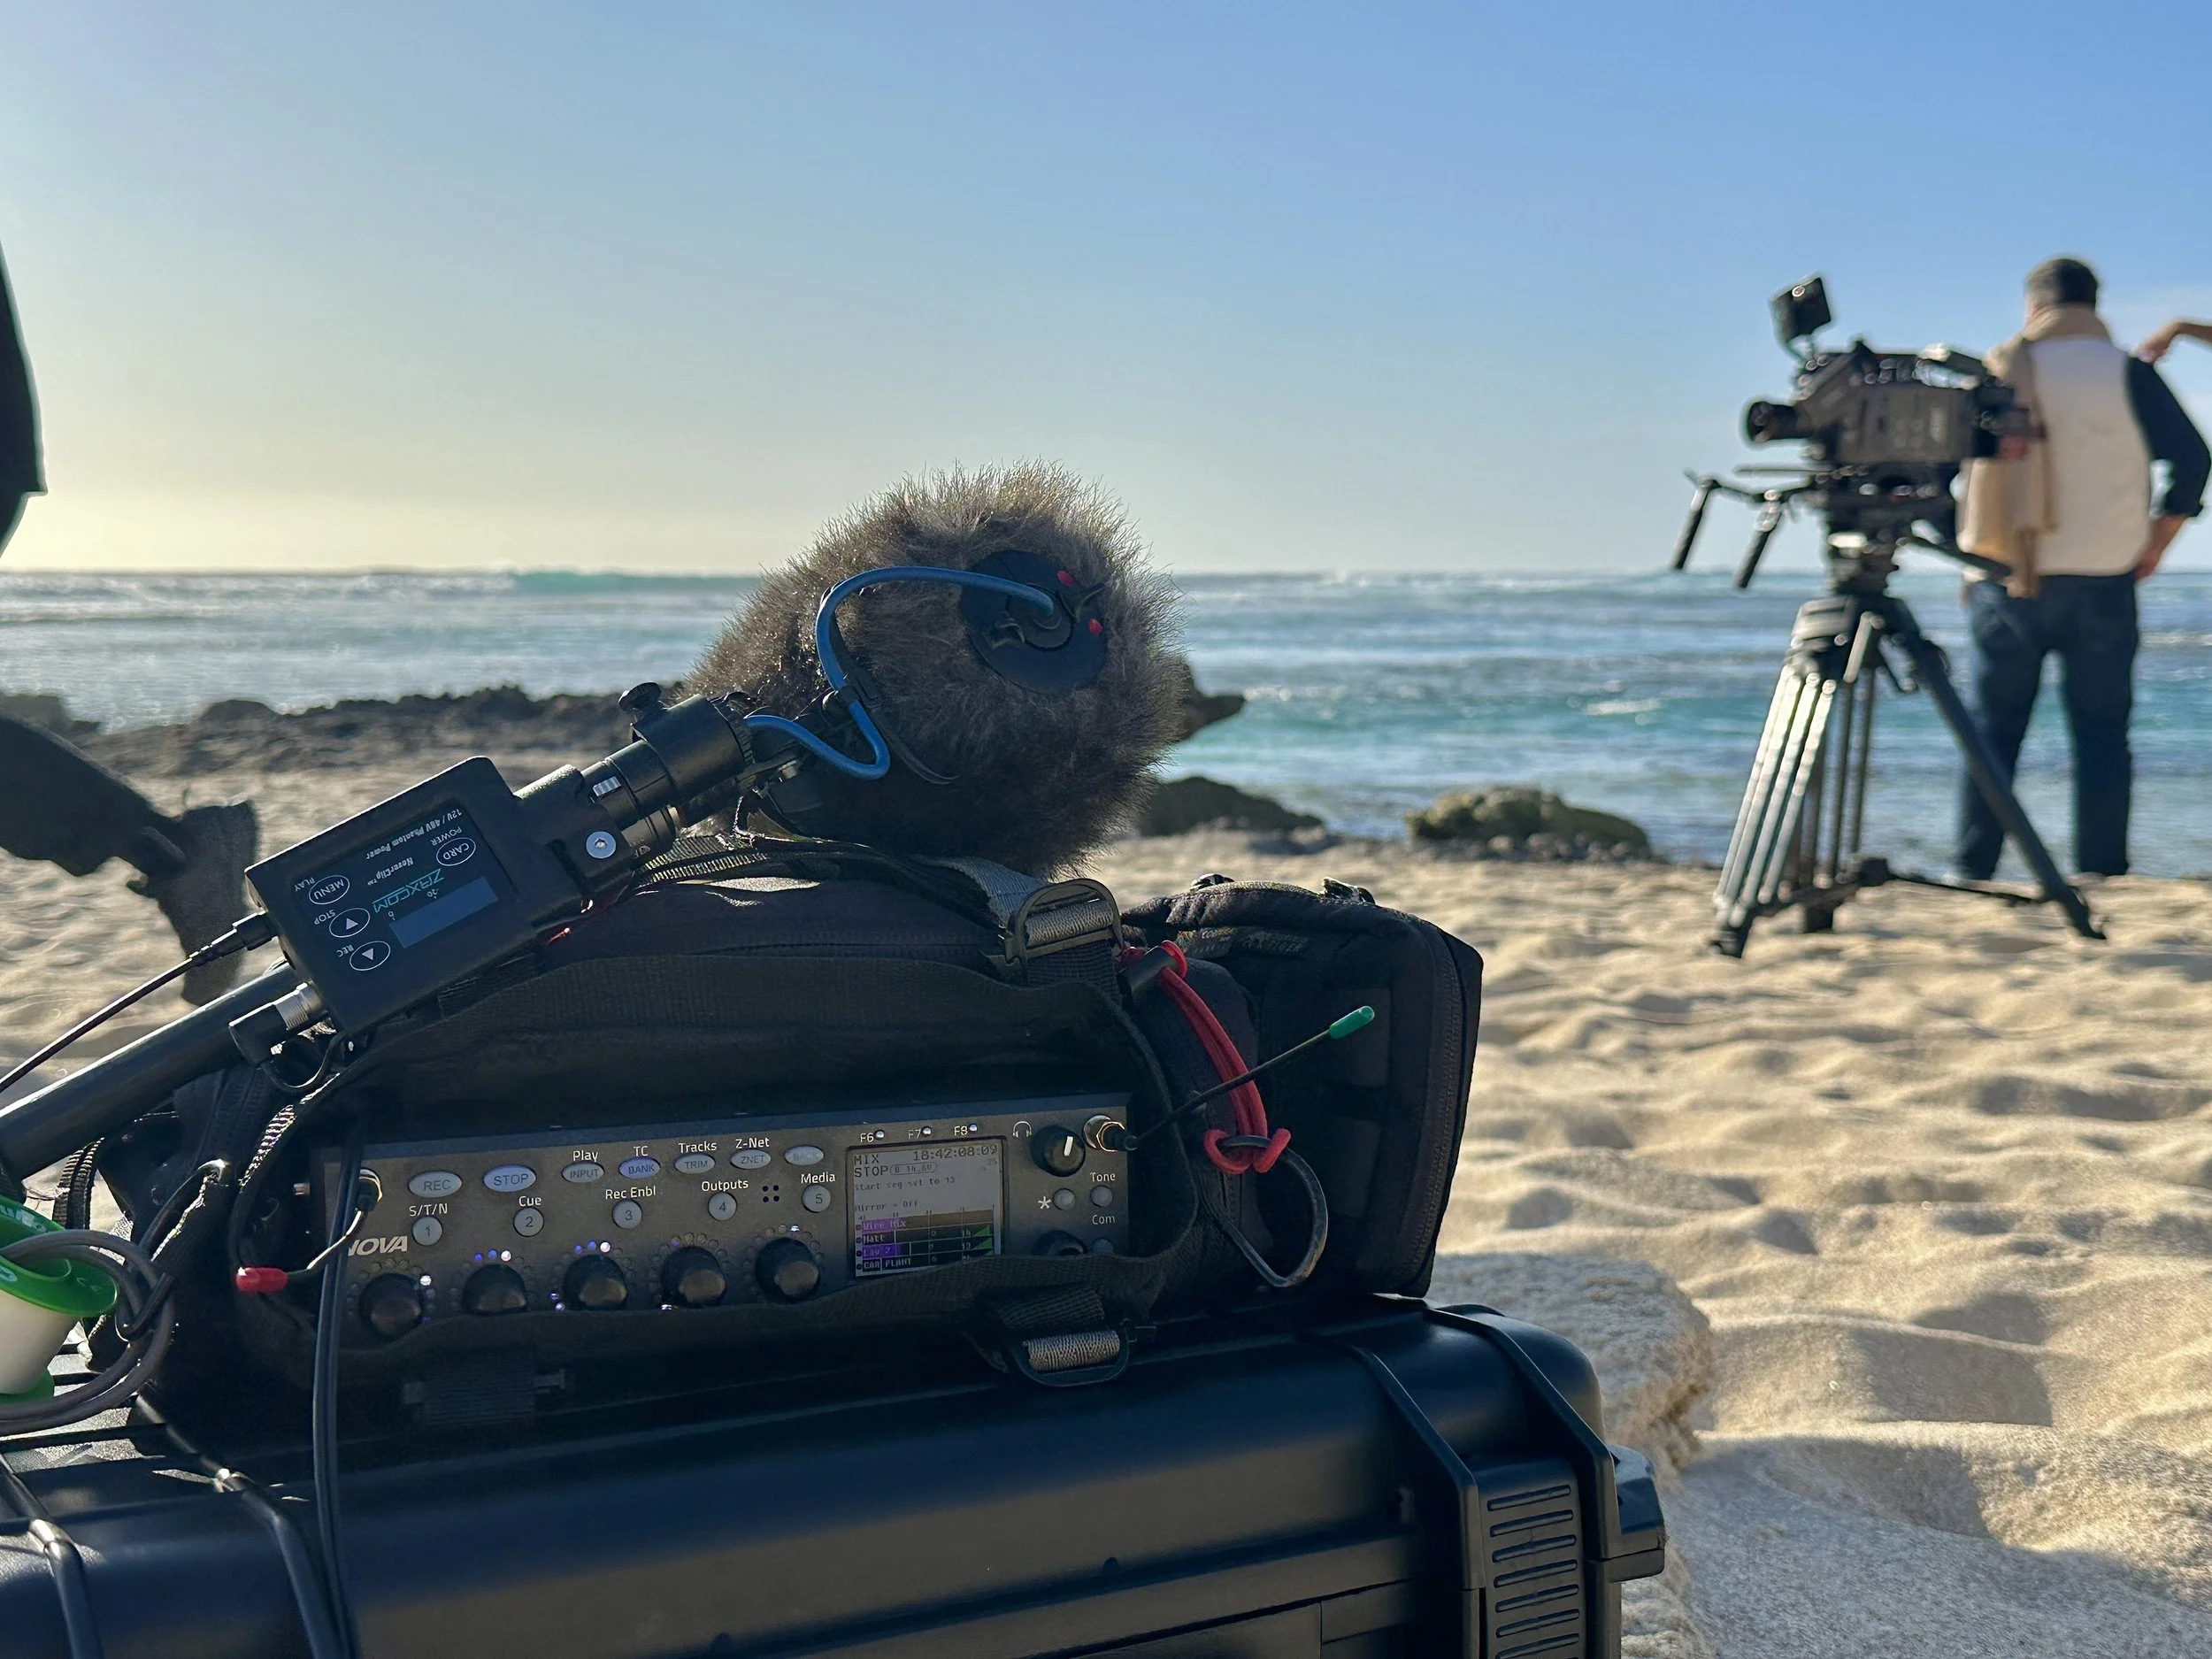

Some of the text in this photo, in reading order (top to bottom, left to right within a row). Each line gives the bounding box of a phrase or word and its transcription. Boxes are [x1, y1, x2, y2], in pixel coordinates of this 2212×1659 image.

[447, 808, 462, 821] 12V
[391, 826, 425, 847] Phantom
[430, 826, 463, 846] POWER
[365, 843, 391, 860] Power
[442, 842, 470, 860] CARD
[294, 877, 316, 892] PLAY
[313, 879, 345, 900] MENU
[372, 868, 444, 913] ZAXCOM
[313, 909, 336, 926] STOP
[336, 944, 354, 957] REC
[908, 1129, 921, 1140] F7
[954, 1125, 968, 1137] F8
[735, 1137, 770, 1148] Z-Net
[860, 1133, 874, 1143] F6
[633, 1145, 649, 1156] TC
[678, 1141, 718, 1154] Tracks
[572, 1149, 598, 1163] Play
[741, 1155, 764, 1164] ZNET
[793, 1152, 818, 1162] BACK
[854, 1154, 879, 1165] MIX
[628, 1164, 655, 1174] BANK
[685, 1160, 708, 1170] TRIM
[570, 1169, 599, 1179] INPUT
[801, 1171, 836, 1184] Media
[854, 1165, 888, 1178] STOP
[1089, 1171, 1116, 1182] Tone
[424, 1179, 451, 1191] REC
[494, 1173, 529, 1187] STOP
[701, 1179, 749, 1192] Outputs
[605, 1186, 656, 1200] Rec Enbl
[815, 1194, 823, 1204] 5
[518, 1195, 542, 1207] Cue
[718, 1202, 726, 1212] 4
[409, 1203, 448, 1217] S/T/N
[625, 1210, 633, 1221] 3
[525, 1216, 534, 1228] 2
[1092, 1214, 1116, 1225] Com
[426, 1225, 431, 1237] 1
